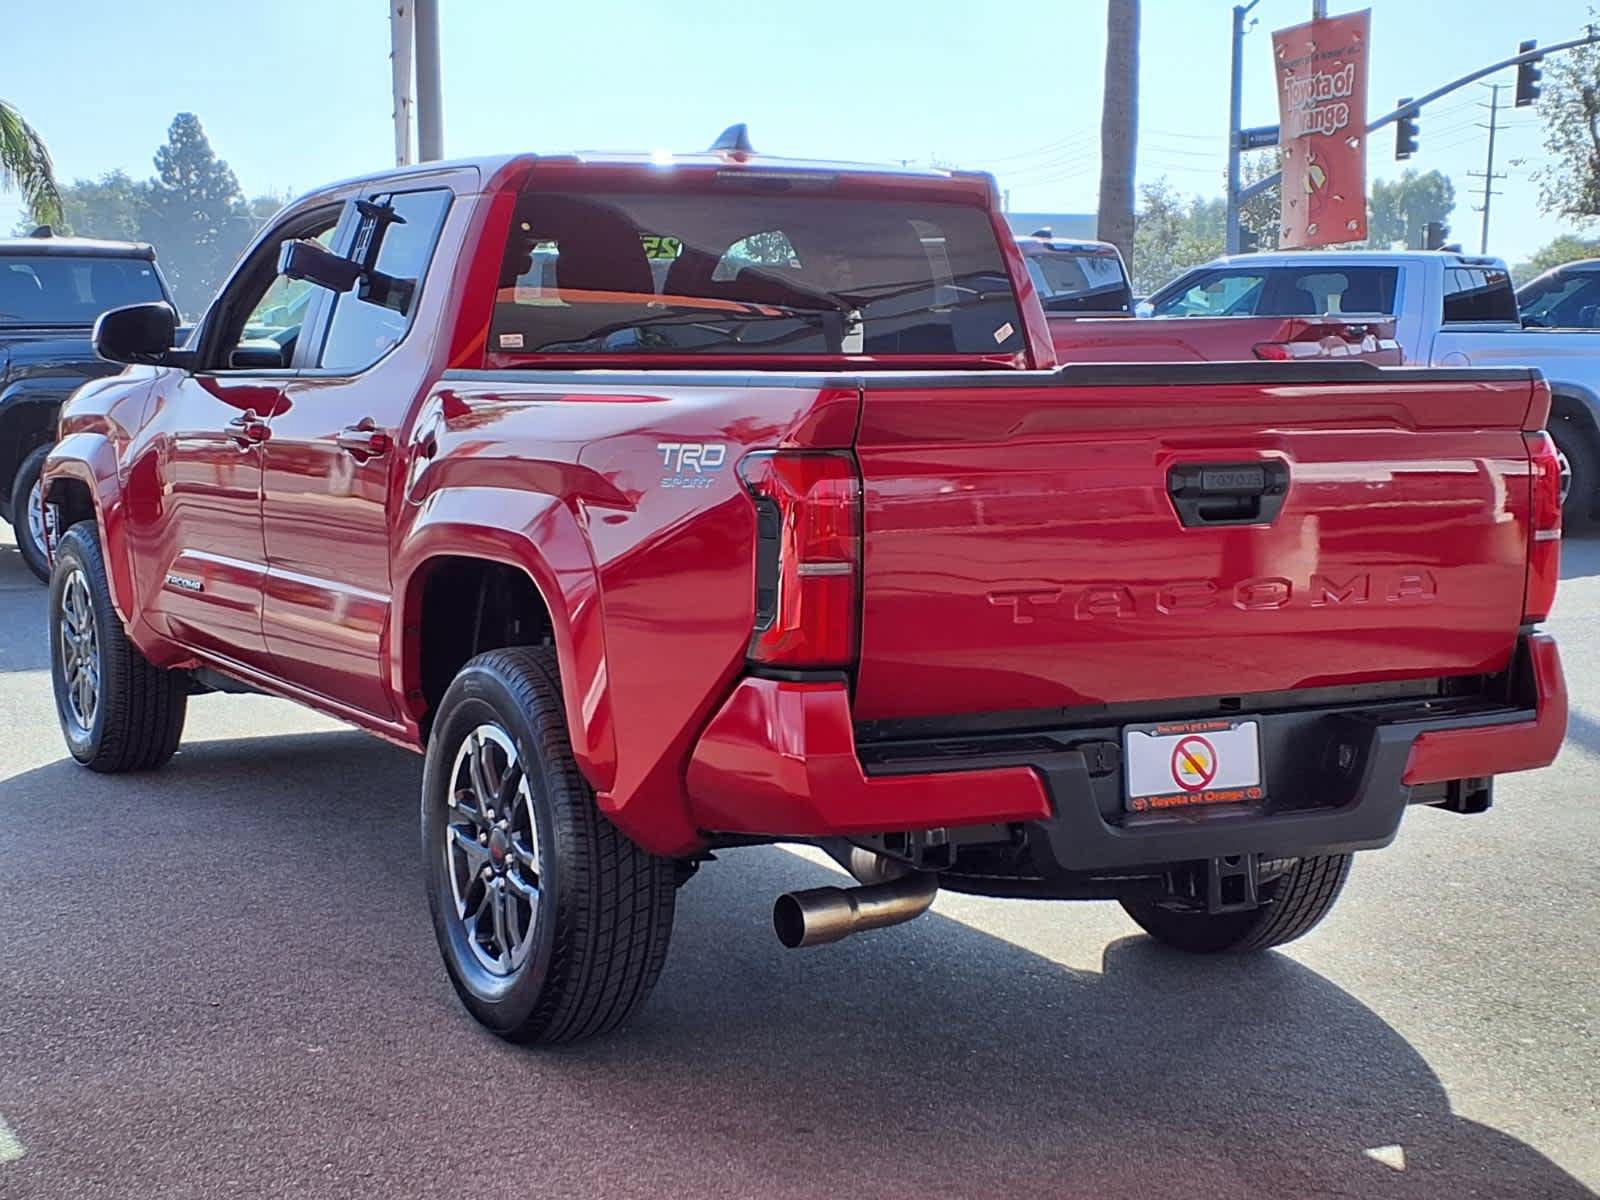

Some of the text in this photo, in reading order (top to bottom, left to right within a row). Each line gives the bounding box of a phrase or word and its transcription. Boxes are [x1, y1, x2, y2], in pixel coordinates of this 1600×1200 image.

[657, 443, 726, 473] TRD
[660, 478, 716, 489] SPORT
[986, 569, 1438, 624] TACOMA
[1150, 795, 1188, 808] Toyota
